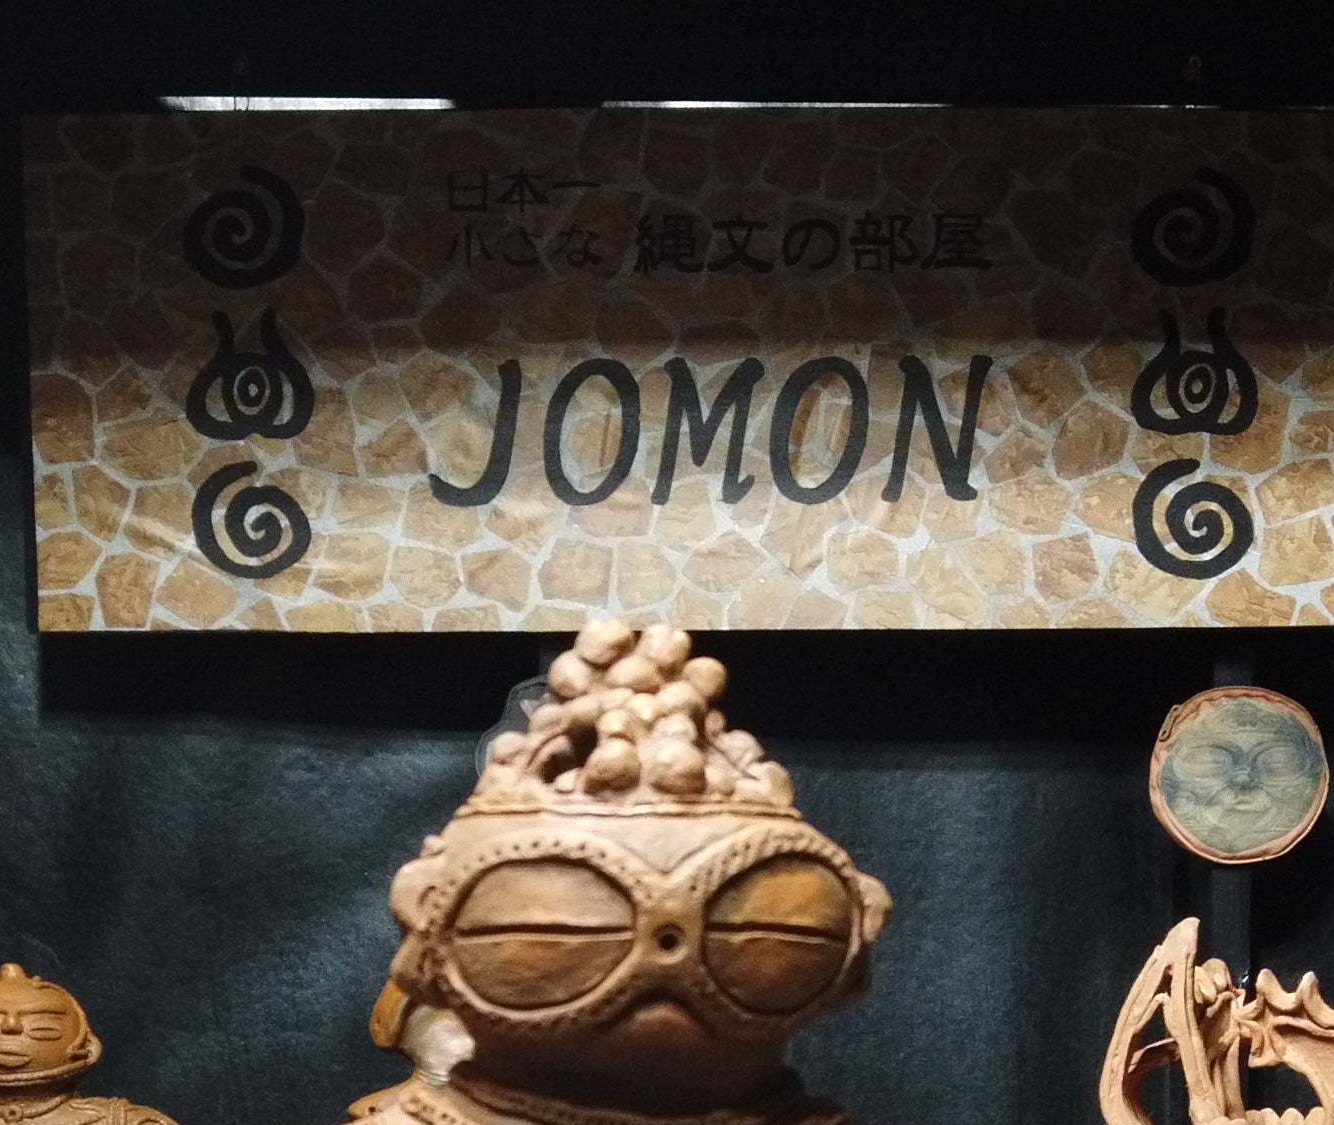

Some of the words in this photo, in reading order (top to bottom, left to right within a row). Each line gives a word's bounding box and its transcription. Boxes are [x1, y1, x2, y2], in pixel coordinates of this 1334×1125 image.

[445, 167, 603, 214] 日本一
[445, 225, 607, 269] 小さな
[633, 212, 994, 274] 縄文の部屋
[428, 355, 994, 507] JOMON
